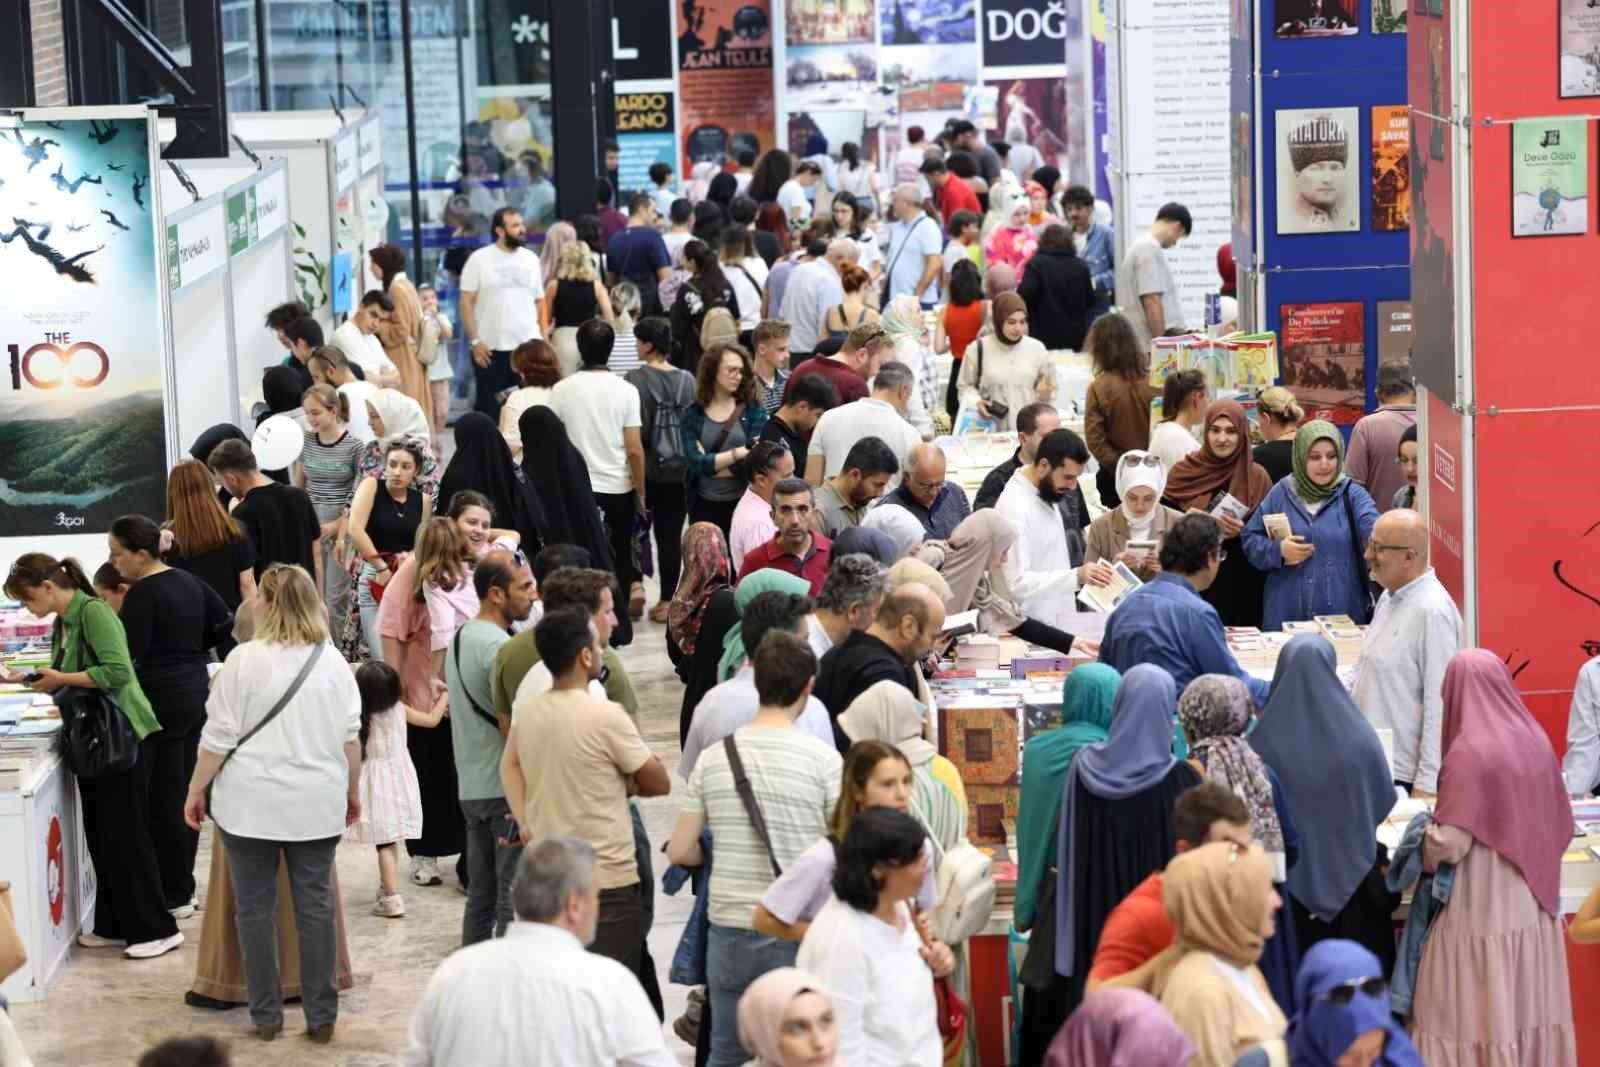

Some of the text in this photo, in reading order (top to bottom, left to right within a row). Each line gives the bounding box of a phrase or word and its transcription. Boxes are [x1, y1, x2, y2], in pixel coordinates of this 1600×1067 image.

[987, 1, 1067, 41] DOĞ
[683, 50, 721, 68] JEAN
[1290, 119, 1345, 142] ATATÜRK
[1523, 151, 1549, 163] Deve
[44, 332, 71, 344] THE
[8, 342, 110, 390] 100
